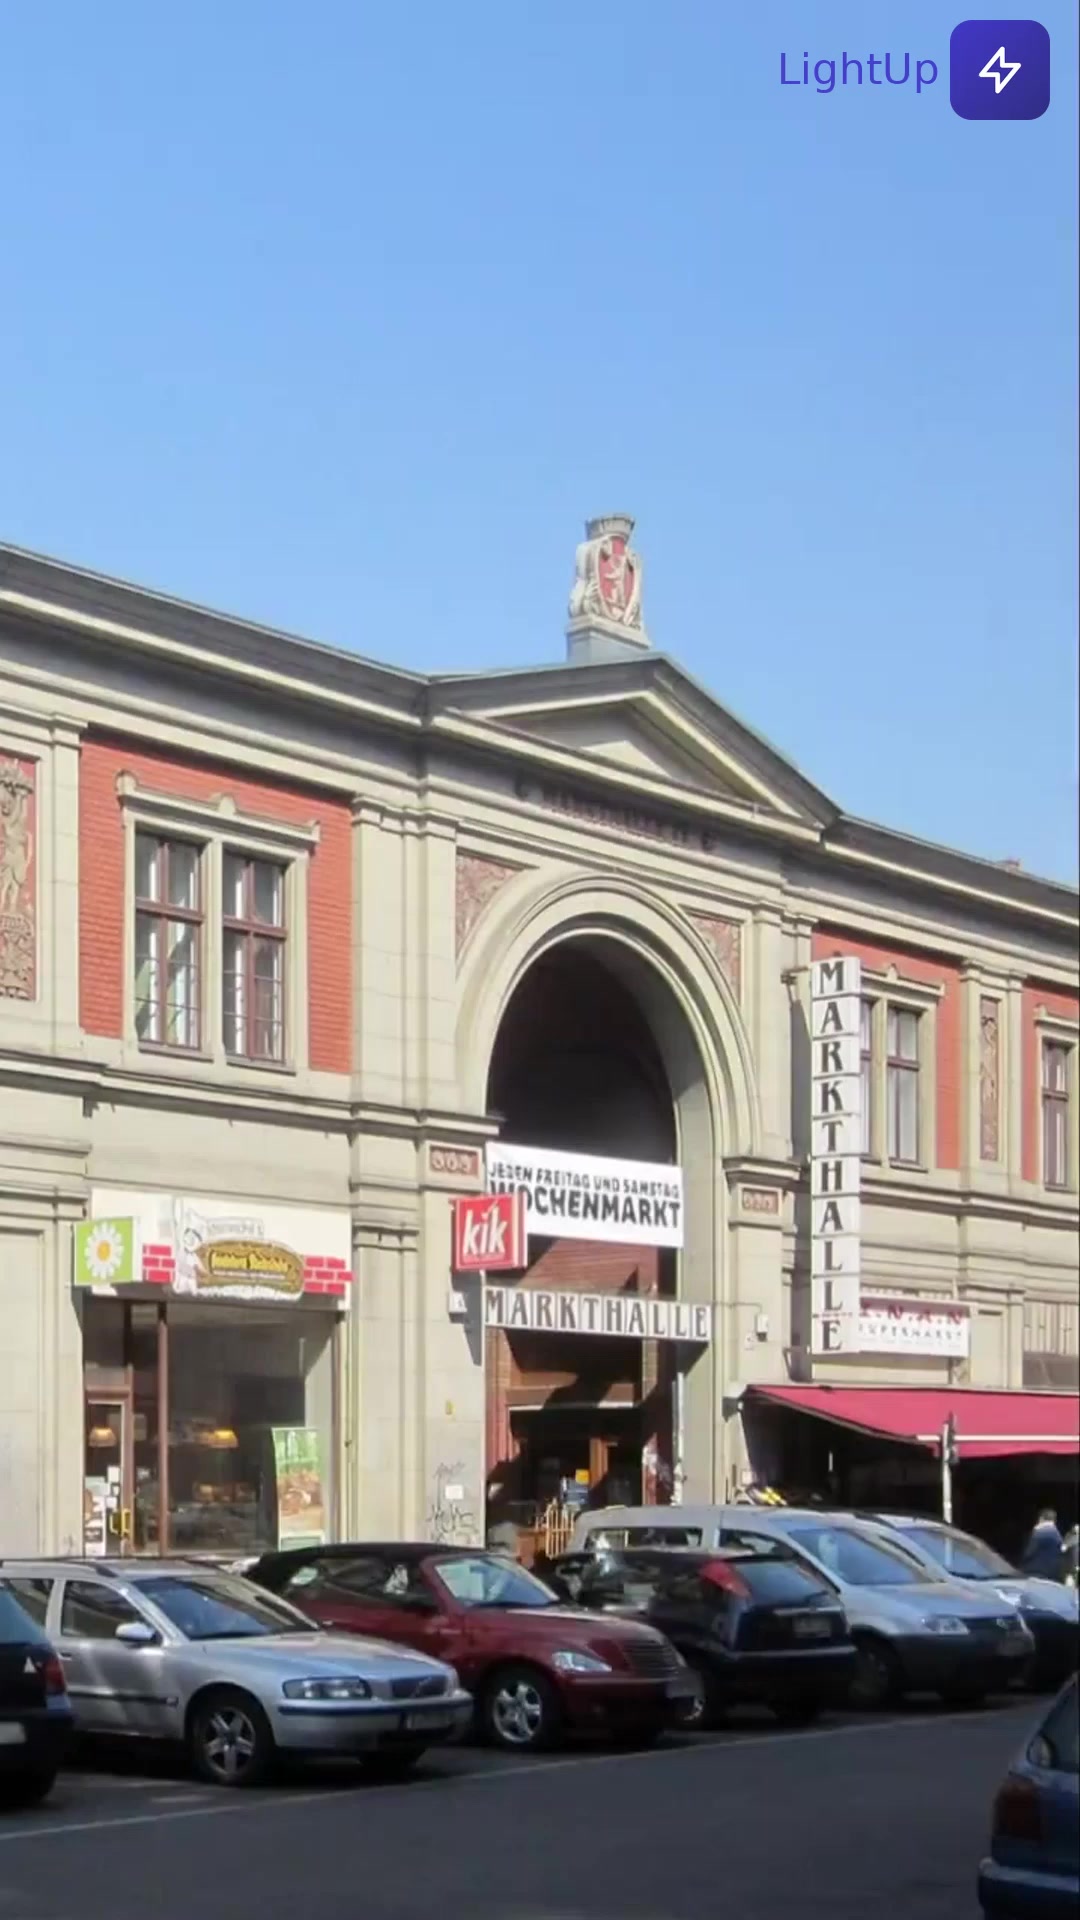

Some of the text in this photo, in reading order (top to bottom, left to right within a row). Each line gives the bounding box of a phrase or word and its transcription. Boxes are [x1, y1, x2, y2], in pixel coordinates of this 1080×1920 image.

[490, 1162, 681, 1200] JEDEN FREITAG UND SAMSTAG
[819, 960, 846, 1352] MARKTHALLE
[463, 1201, 508, 1256] kik
[486, 1289, 709, 1338] MARKTHALLE
